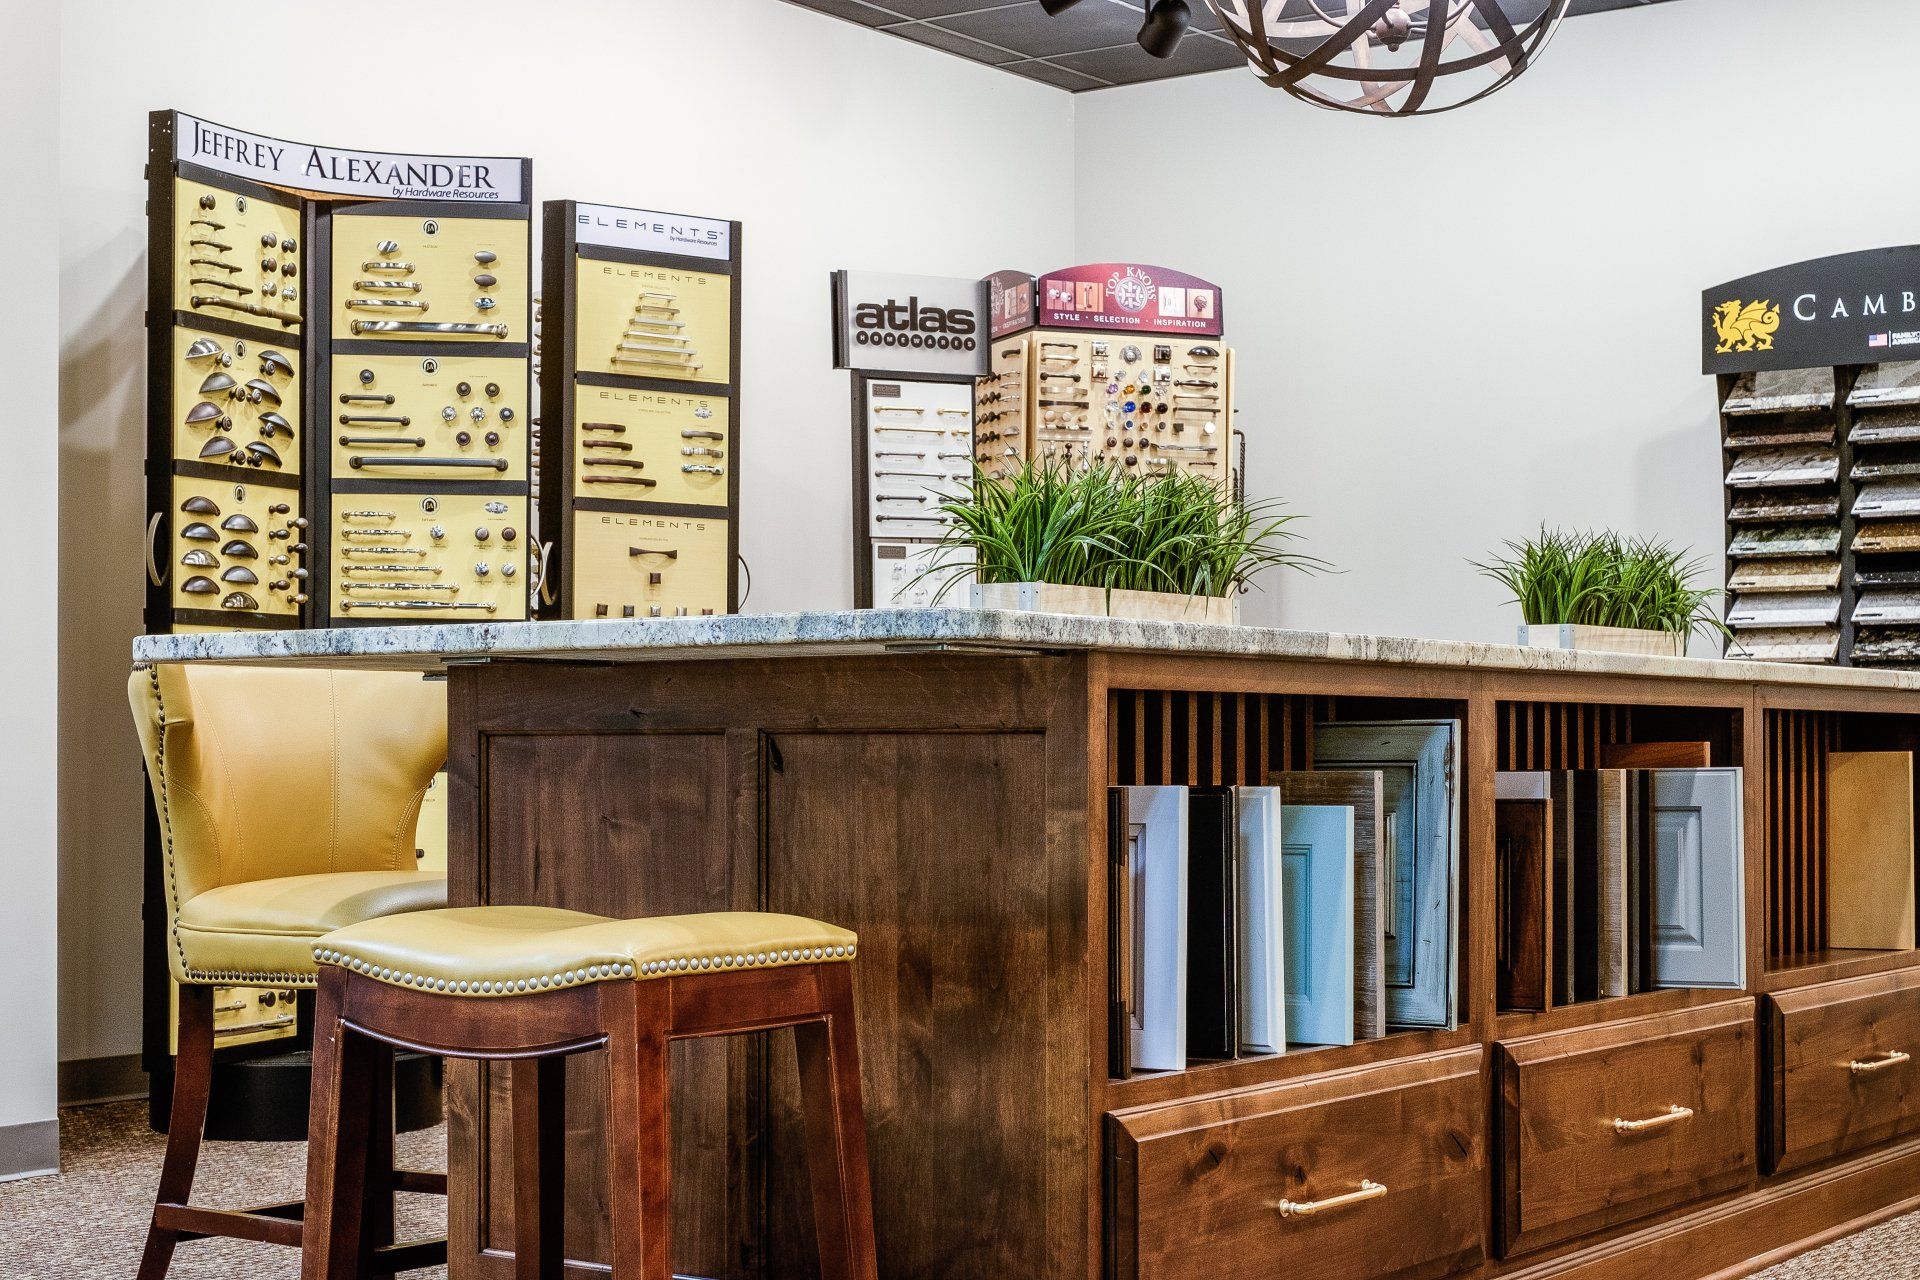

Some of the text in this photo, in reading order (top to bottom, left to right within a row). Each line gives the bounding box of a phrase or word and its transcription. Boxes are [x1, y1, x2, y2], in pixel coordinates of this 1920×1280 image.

[192, 121, 496, 189] JEFFREY ALEXANDER
[392, 187, 500, 199] by Hardware Resources
[603, 267, 707, 285] ELEMENTS
[1105, 266, 1157, 300] TOP KNOBS
[855, 296, 976, 335] atlas
[1053, 313, 1206, 328] STYLE SELECTION INSPIRATION
[857, 332, 975, 350] HOMEWARES
[599, 391, 708, 408] ELEMENTS
[602, 516, 705, 531] ELEMENTS
